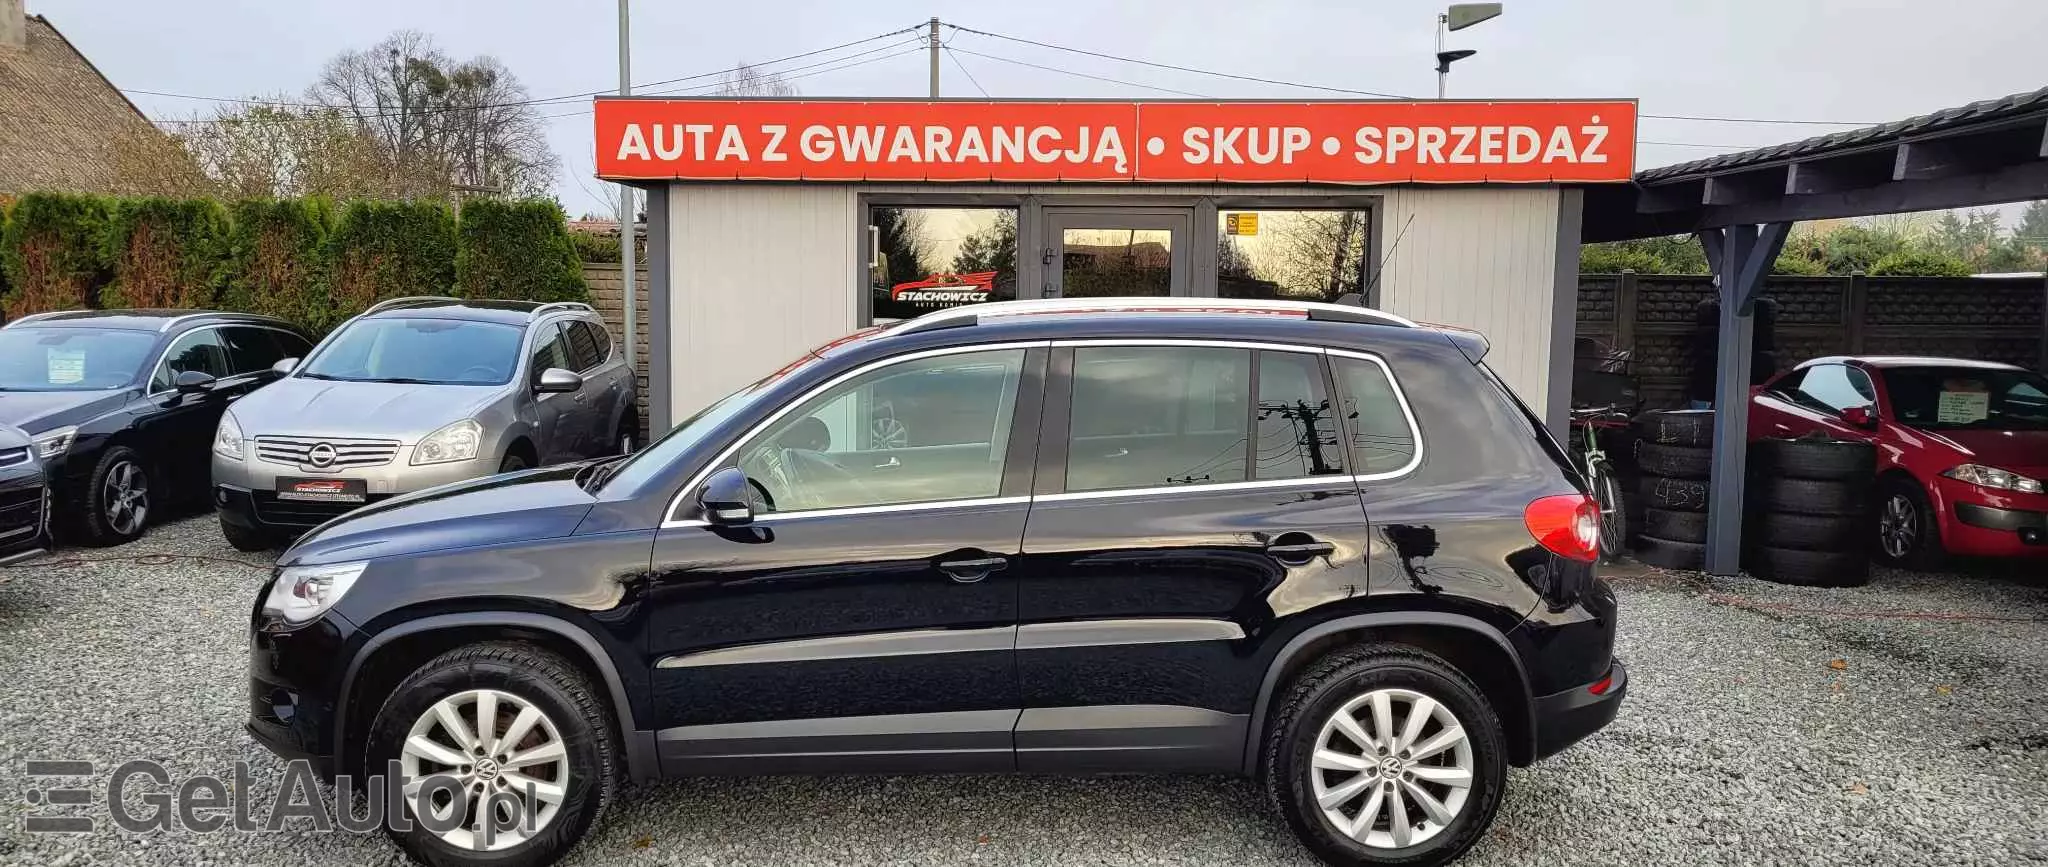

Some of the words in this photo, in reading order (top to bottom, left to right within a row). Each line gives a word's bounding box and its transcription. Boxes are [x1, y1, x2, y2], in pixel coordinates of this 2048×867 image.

[617, 123, 750, 161] AUTA
[761, 124, 788, 162] Z
[800, 125, 1128, 174] GWARANCJĄ
[1182, 126, 1311, 165] SKUP
[1355, 115, 1609, 165] SPRZEDAŻ
[896, 292, 988, 301] STACHOWICZ
